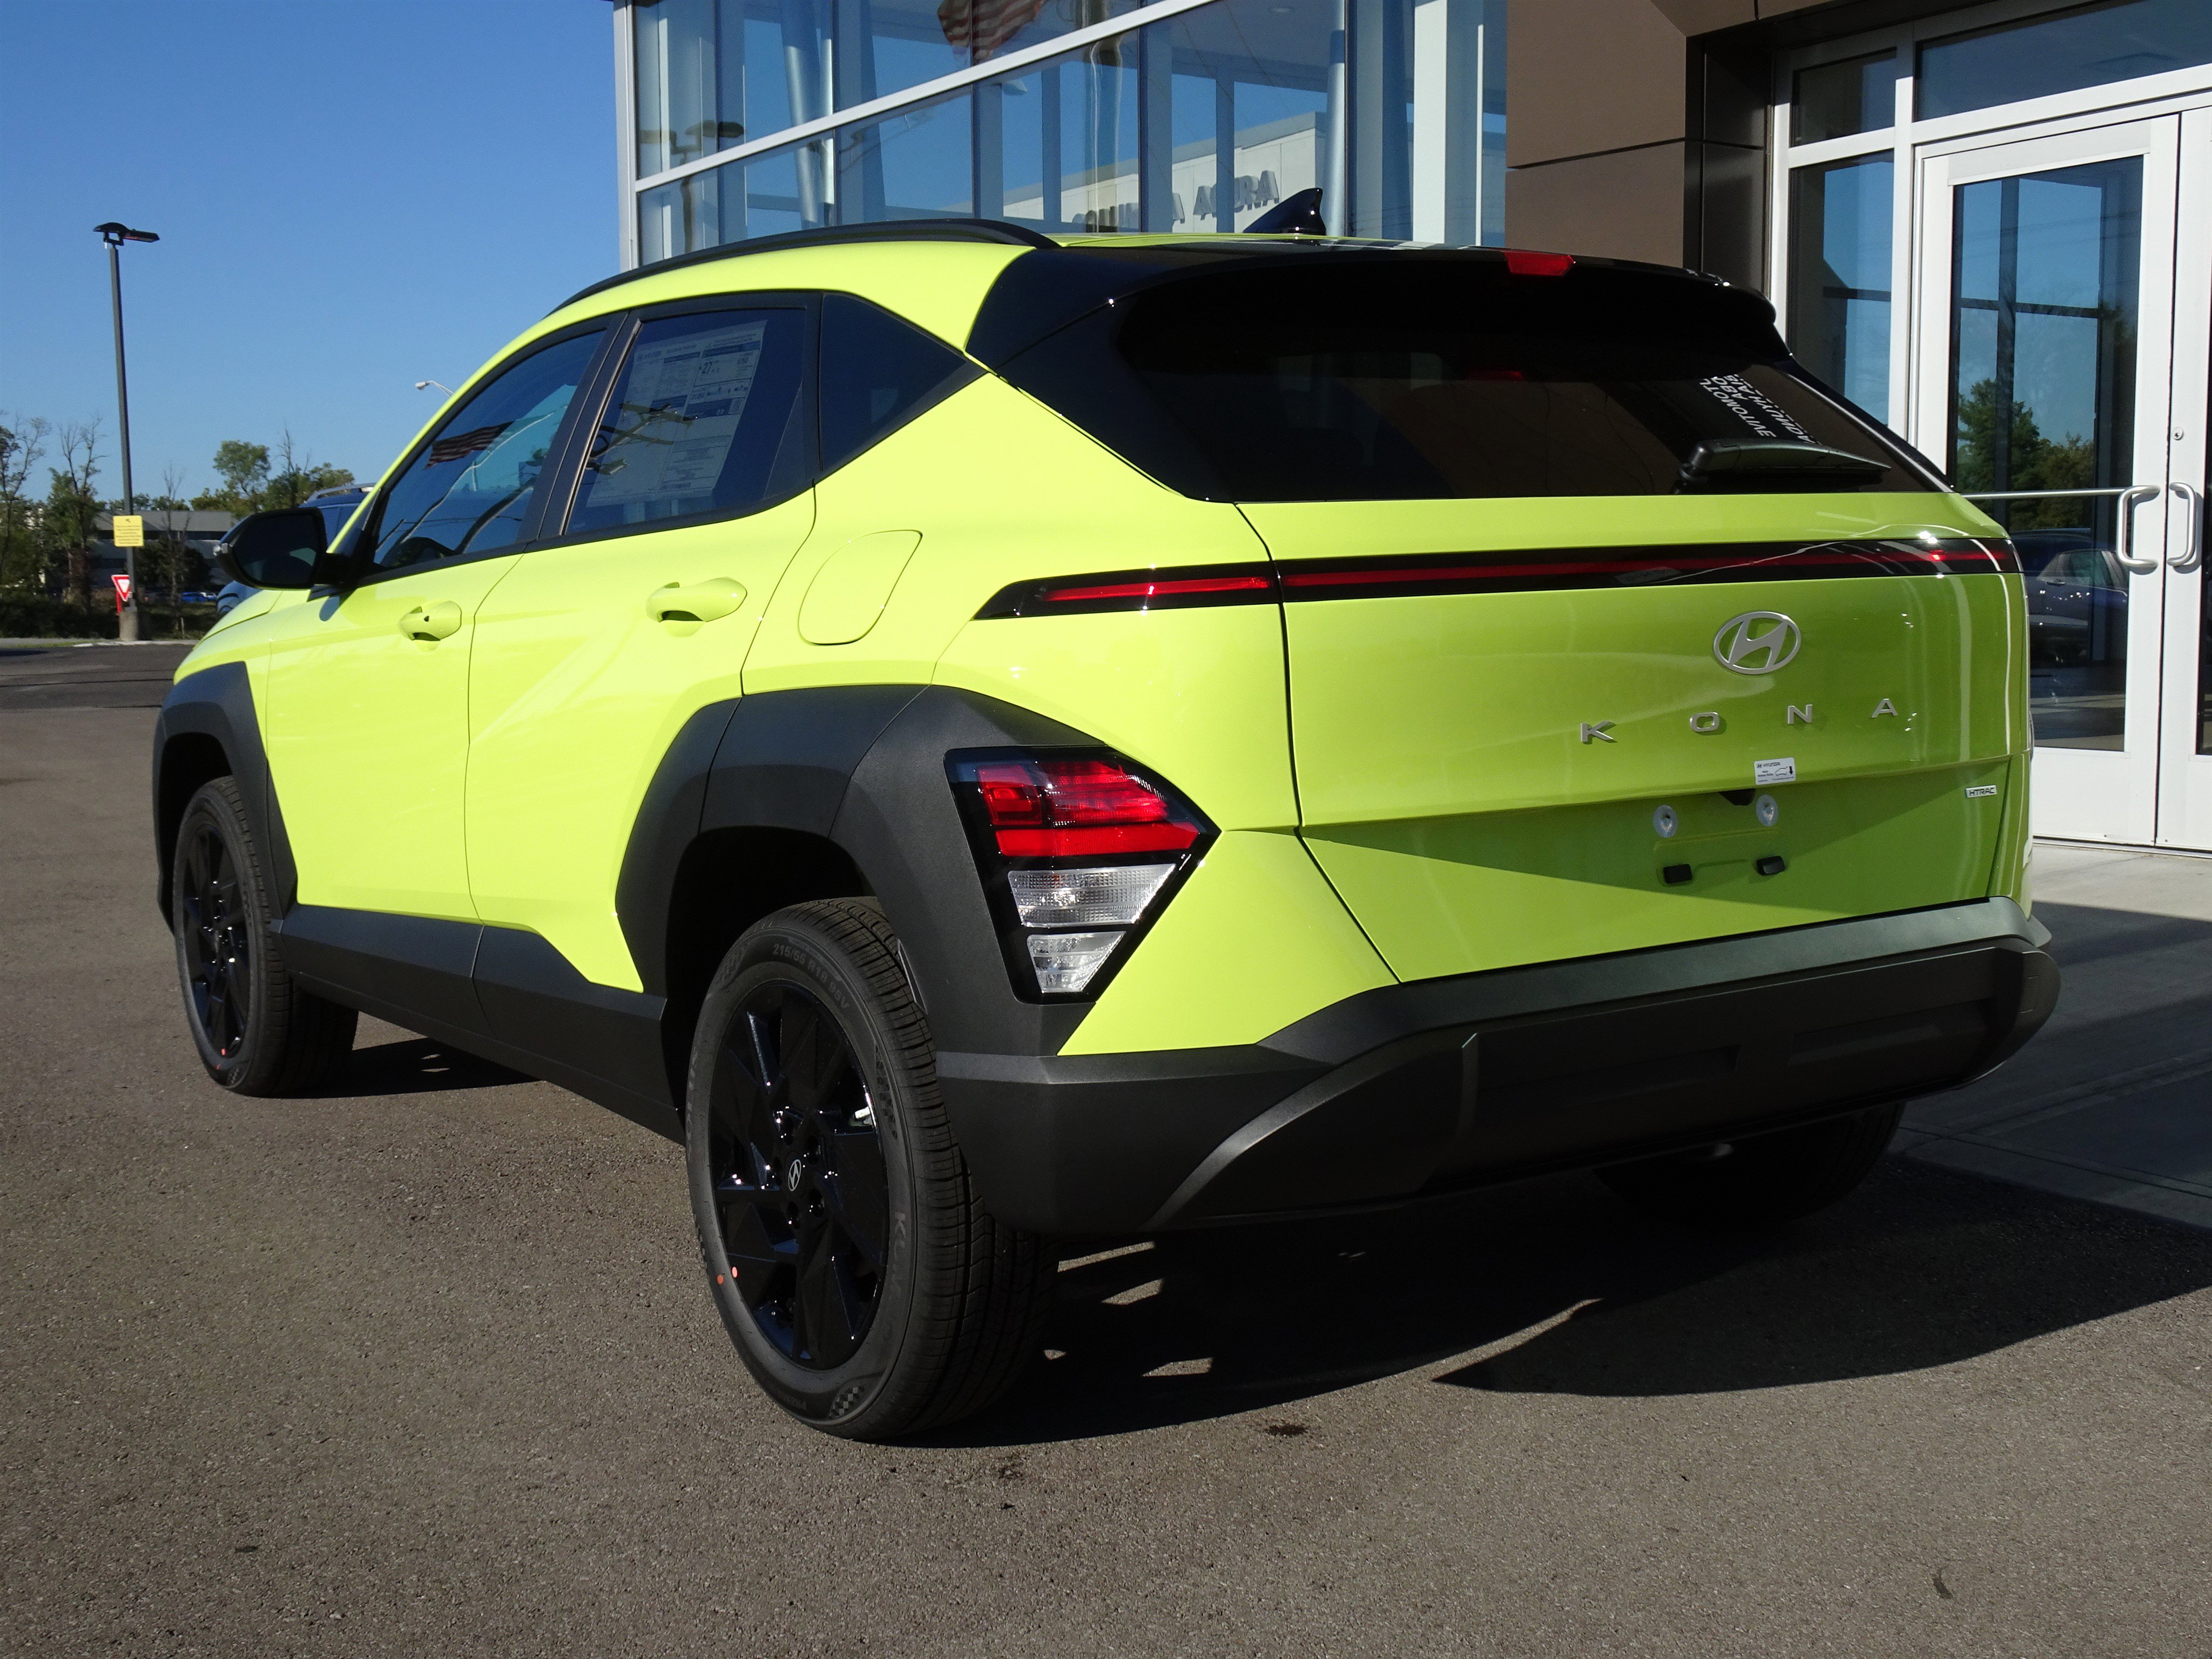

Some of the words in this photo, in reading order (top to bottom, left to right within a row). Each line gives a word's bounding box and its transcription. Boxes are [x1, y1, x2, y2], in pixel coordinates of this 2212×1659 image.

[1193, 170, 1280, 220] AURA
[1580, 698, 1899, 744] KONA
[1969, 787, 1995, 796] HTRAC
